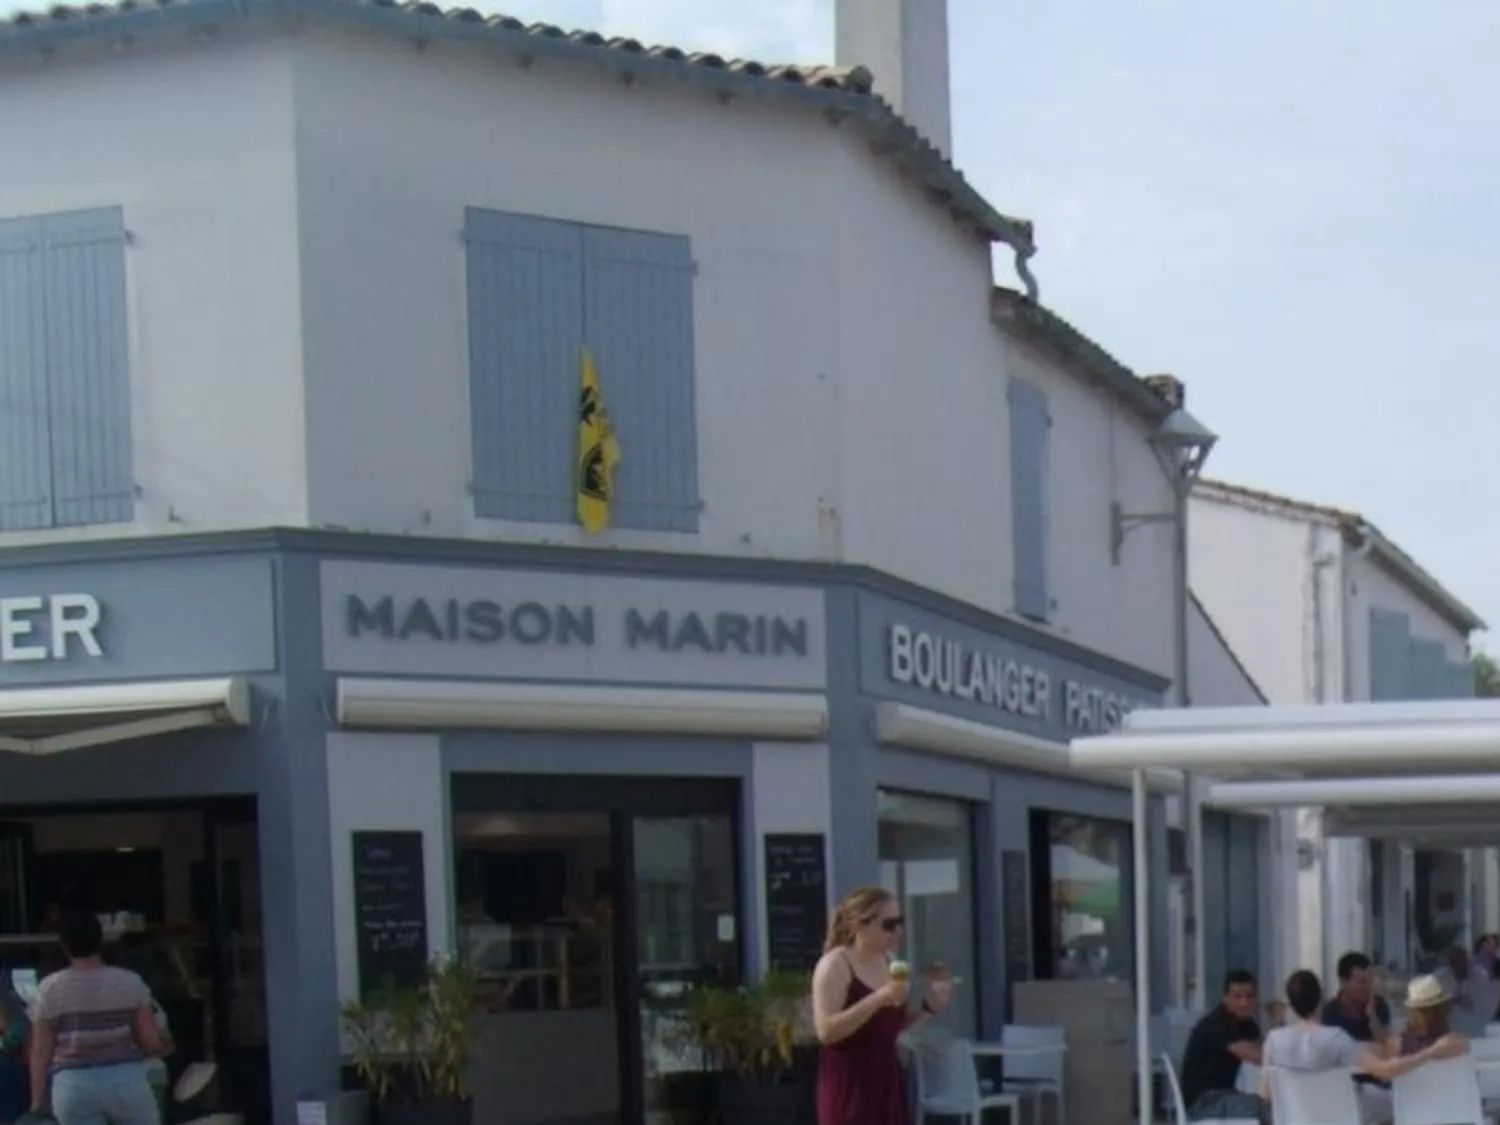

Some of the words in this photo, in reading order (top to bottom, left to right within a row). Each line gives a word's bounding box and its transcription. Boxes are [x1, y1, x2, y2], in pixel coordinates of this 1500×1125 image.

[346, 594, 593, 646] MAISON
[626, 608, 808, 657] MARIN
[891, 624, 1051, 716] BOULANGER
